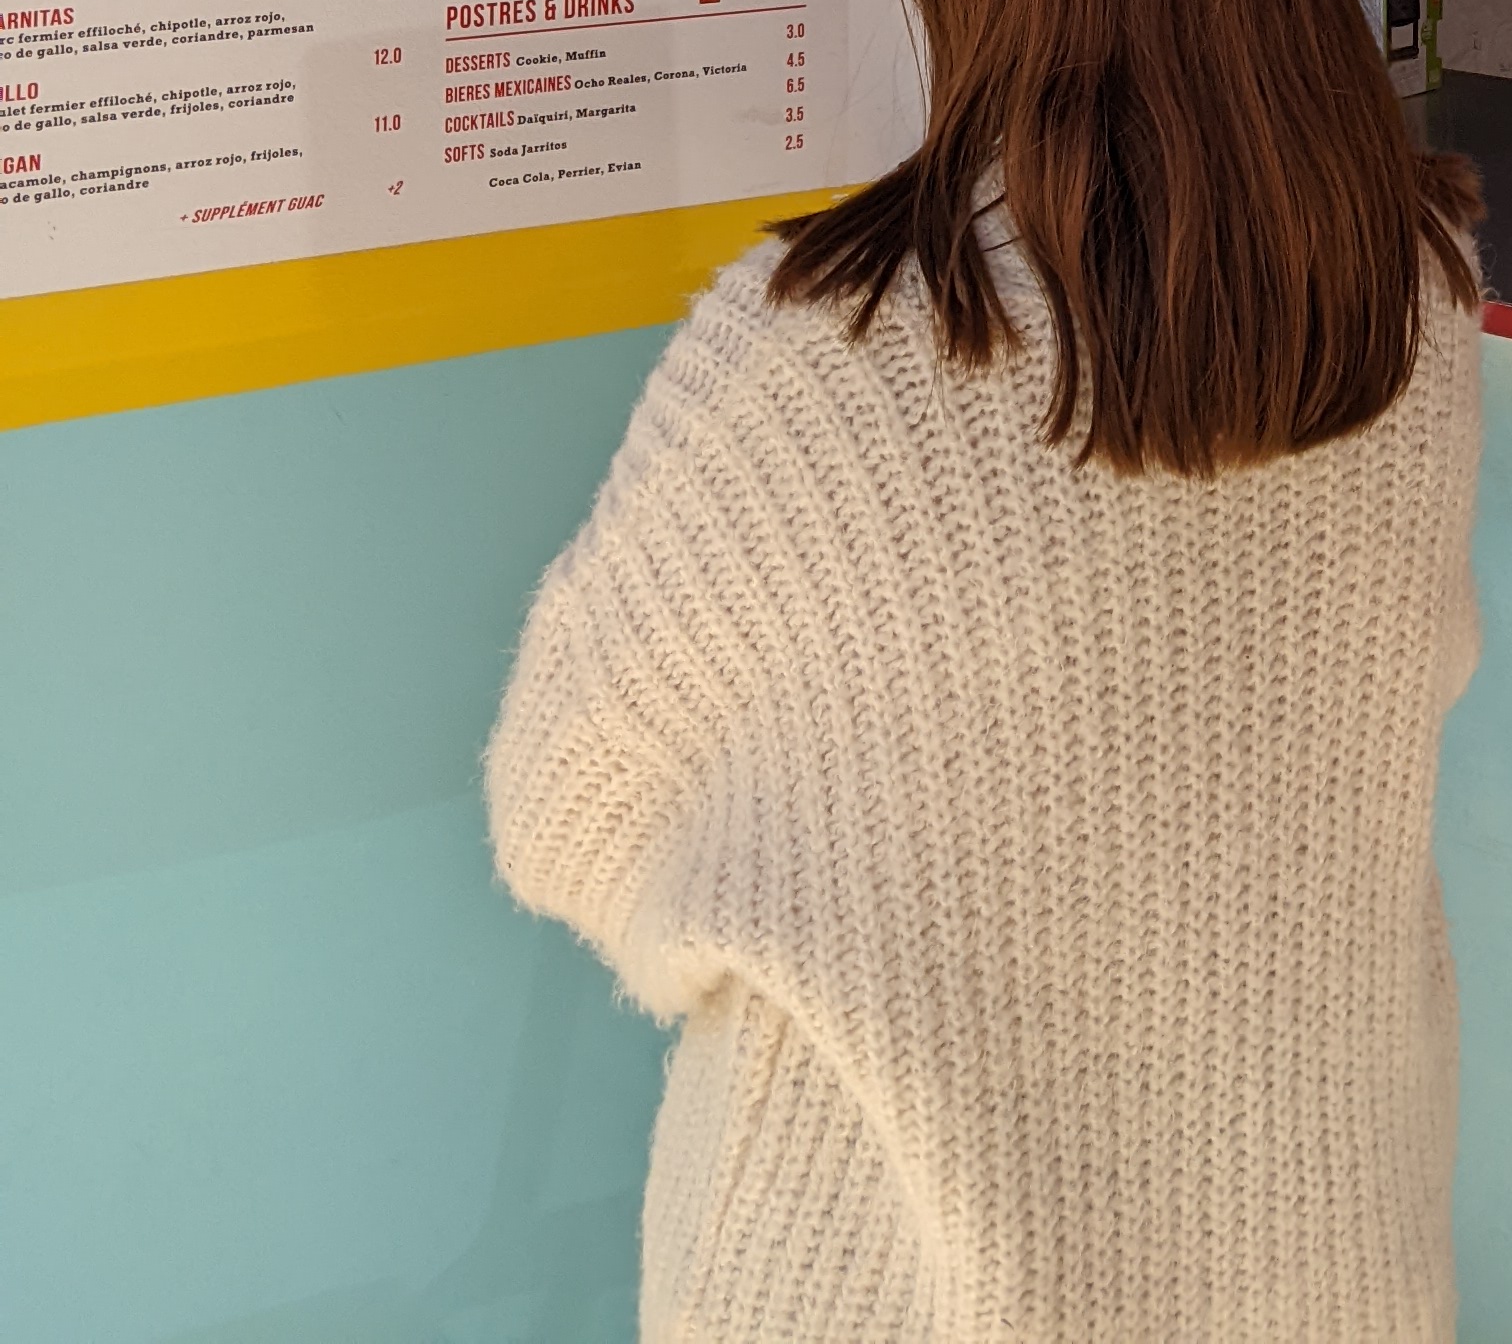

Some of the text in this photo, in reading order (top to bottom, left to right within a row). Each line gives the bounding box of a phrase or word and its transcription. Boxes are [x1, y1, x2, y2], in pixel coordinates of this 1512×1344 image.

[447, 0, 536, 30] POSTRES
[787, 23, 805, 39] 3.0
[374, 47, 401, 65] 12.0
[446, 49, 606, 73] DESSERTS Cookie, Muffin
[787, 52, 805, 67] 4.5
[446, 63, 747, 103] BIERES MEXICAINES Ocho Reales, Corona, Victoria
[787, 77, 805, 93] 6.5
[375, 114, 401, 132] 11.0
[445, 104, 636, 133] COCKTAILS Daïquiri, Margarita
[786, 106, 804, 122] 3.5
[785, 134, 803, 150] 2.5
[445, 142, 567, 163] SOFTS Soda Jarritos
[489, 162, 641, 187] Coca Cola, Perrier, Evian
[388, 180, 404, 195] +2
[192, 194, 325, 223] SUPPLÉMENT GUAC
